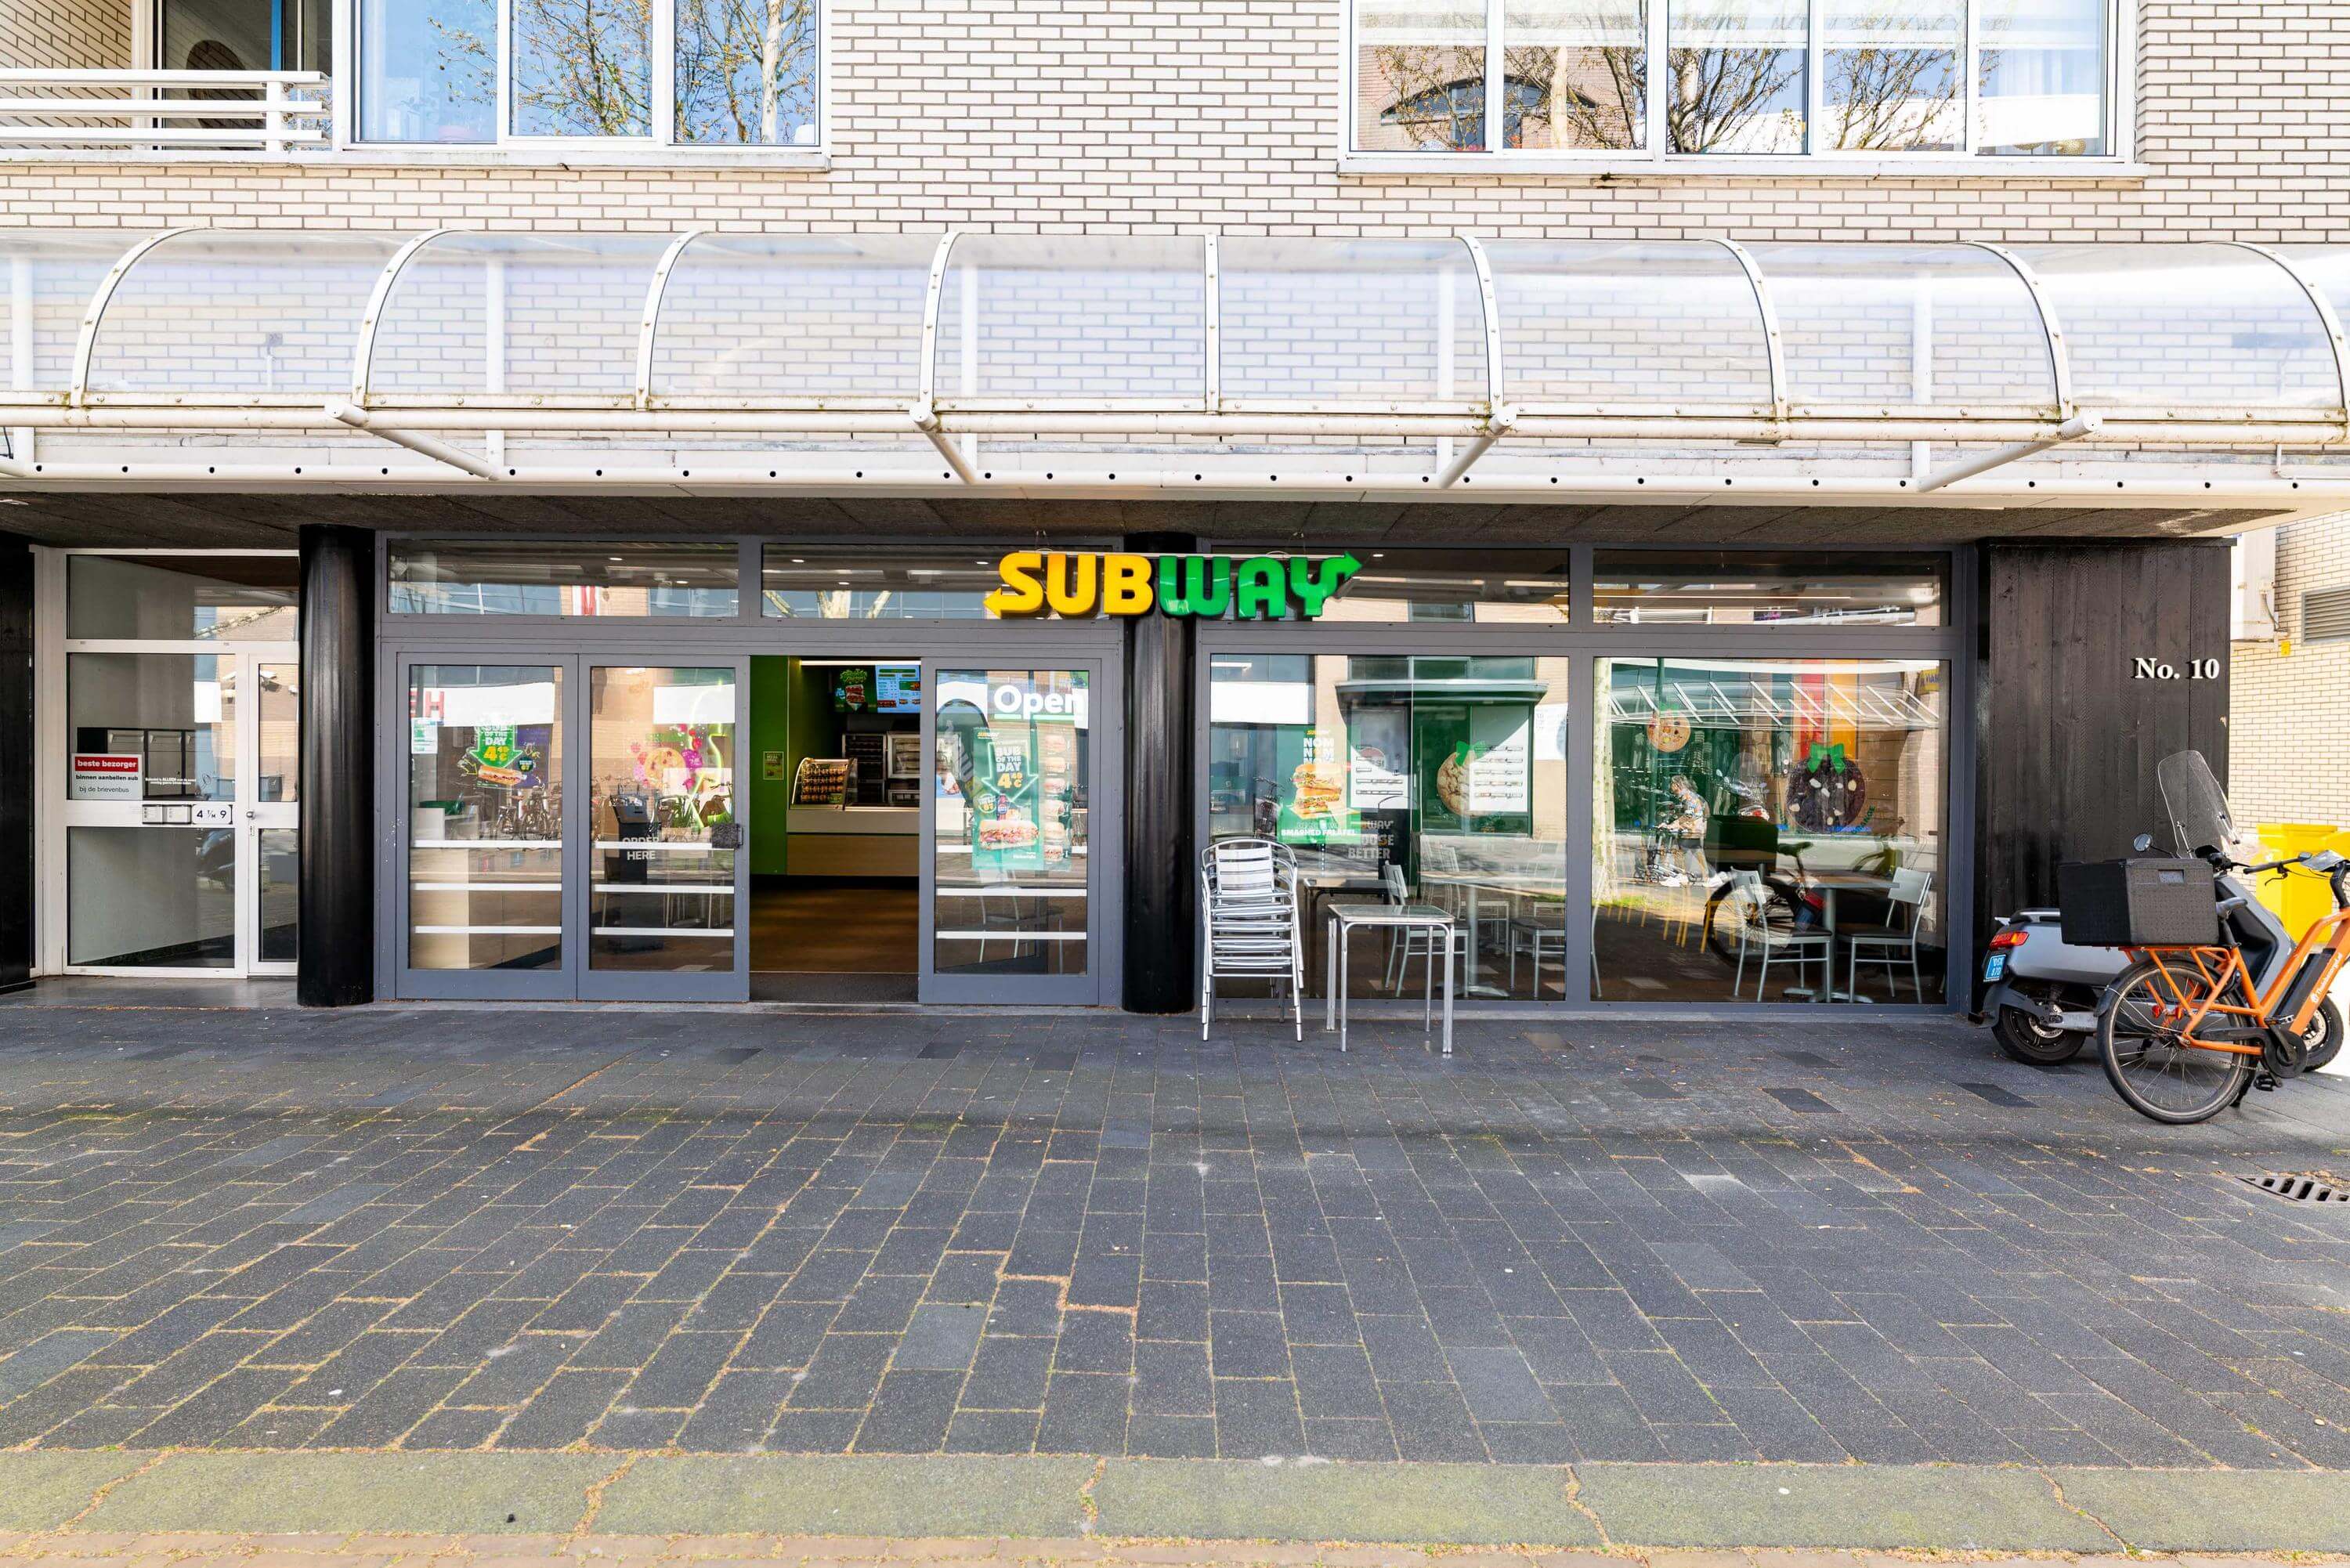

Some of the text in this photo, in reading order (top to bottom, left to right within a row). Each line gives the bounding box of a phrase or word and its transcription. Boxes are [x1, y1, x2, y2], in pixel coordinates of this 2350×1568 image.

[984, 551, 1363, 618] SUBWAY
[2135, 658, 2220, 679] No. 10
[993, 685, 1083, 721] Open
[485, 737, 508, 746] DAY
[995, 746, 1021, 756] SUB
[78, 759, 137, 769] beste bezorger
[996, 763, 1021, 772] DAY
[197, 810, 203, 818] 4
[220, 810, 227, 819] 9
[627, 851, 656, 860] HERE
[1348, 847, 1390, 859] BETTER
